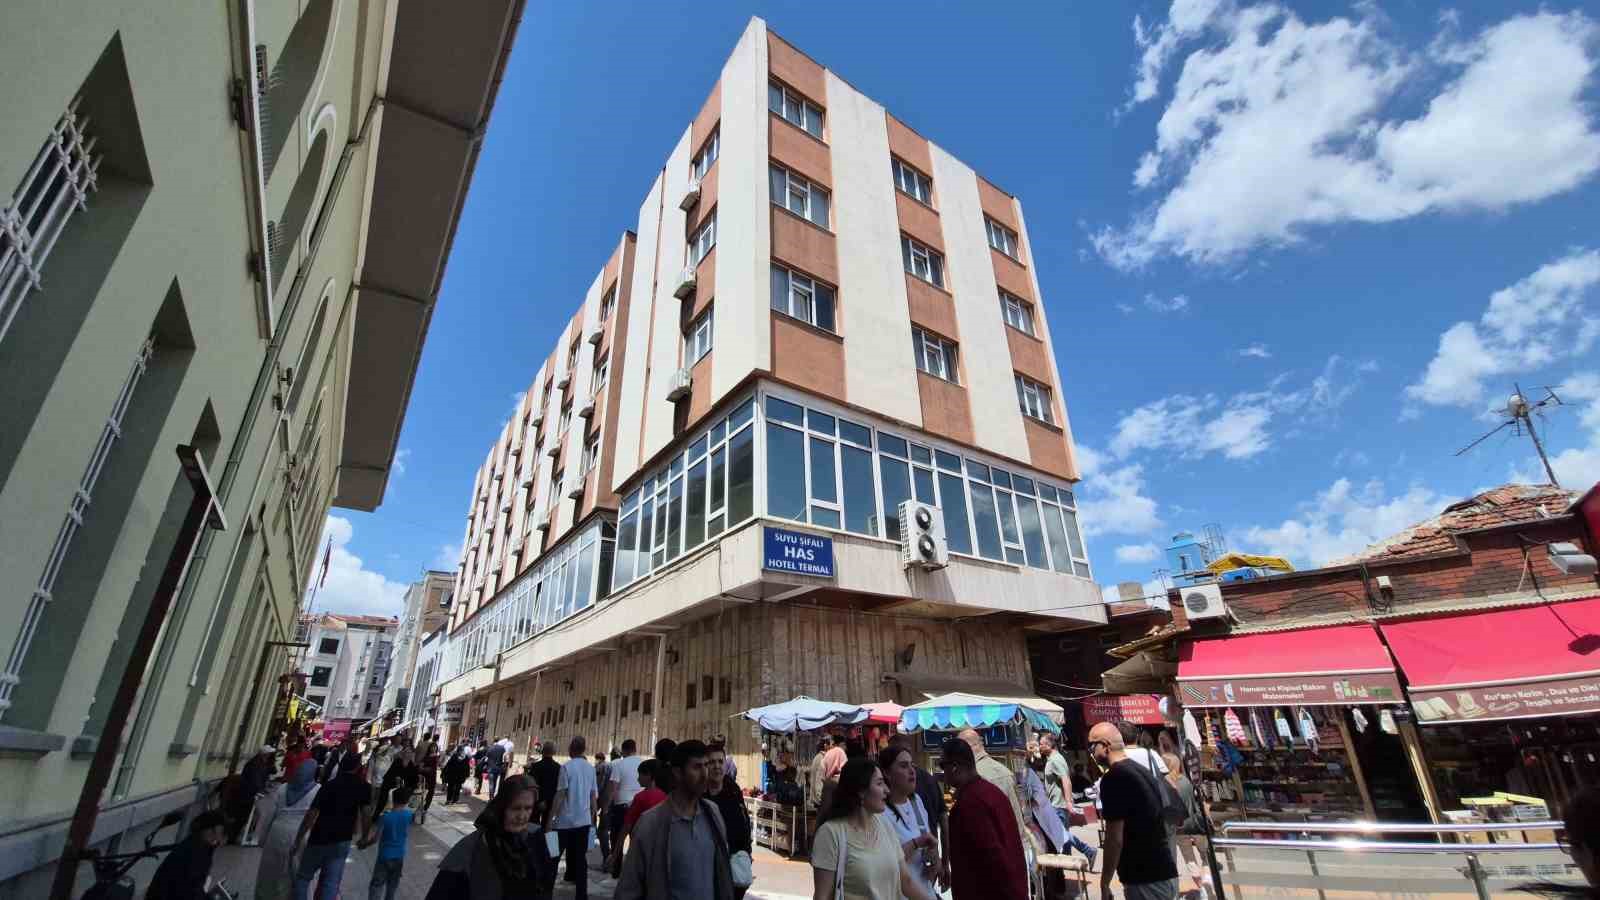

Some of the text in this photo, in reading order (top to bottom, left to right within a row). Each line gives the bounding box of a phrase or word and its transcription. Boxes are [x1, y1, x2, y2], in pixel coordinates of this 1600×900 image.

[774, 533, 798, 544] SUYU
[784, 546, 815, 561] HAS
[768, 559, 829, 574] HOTEL TERMAL
